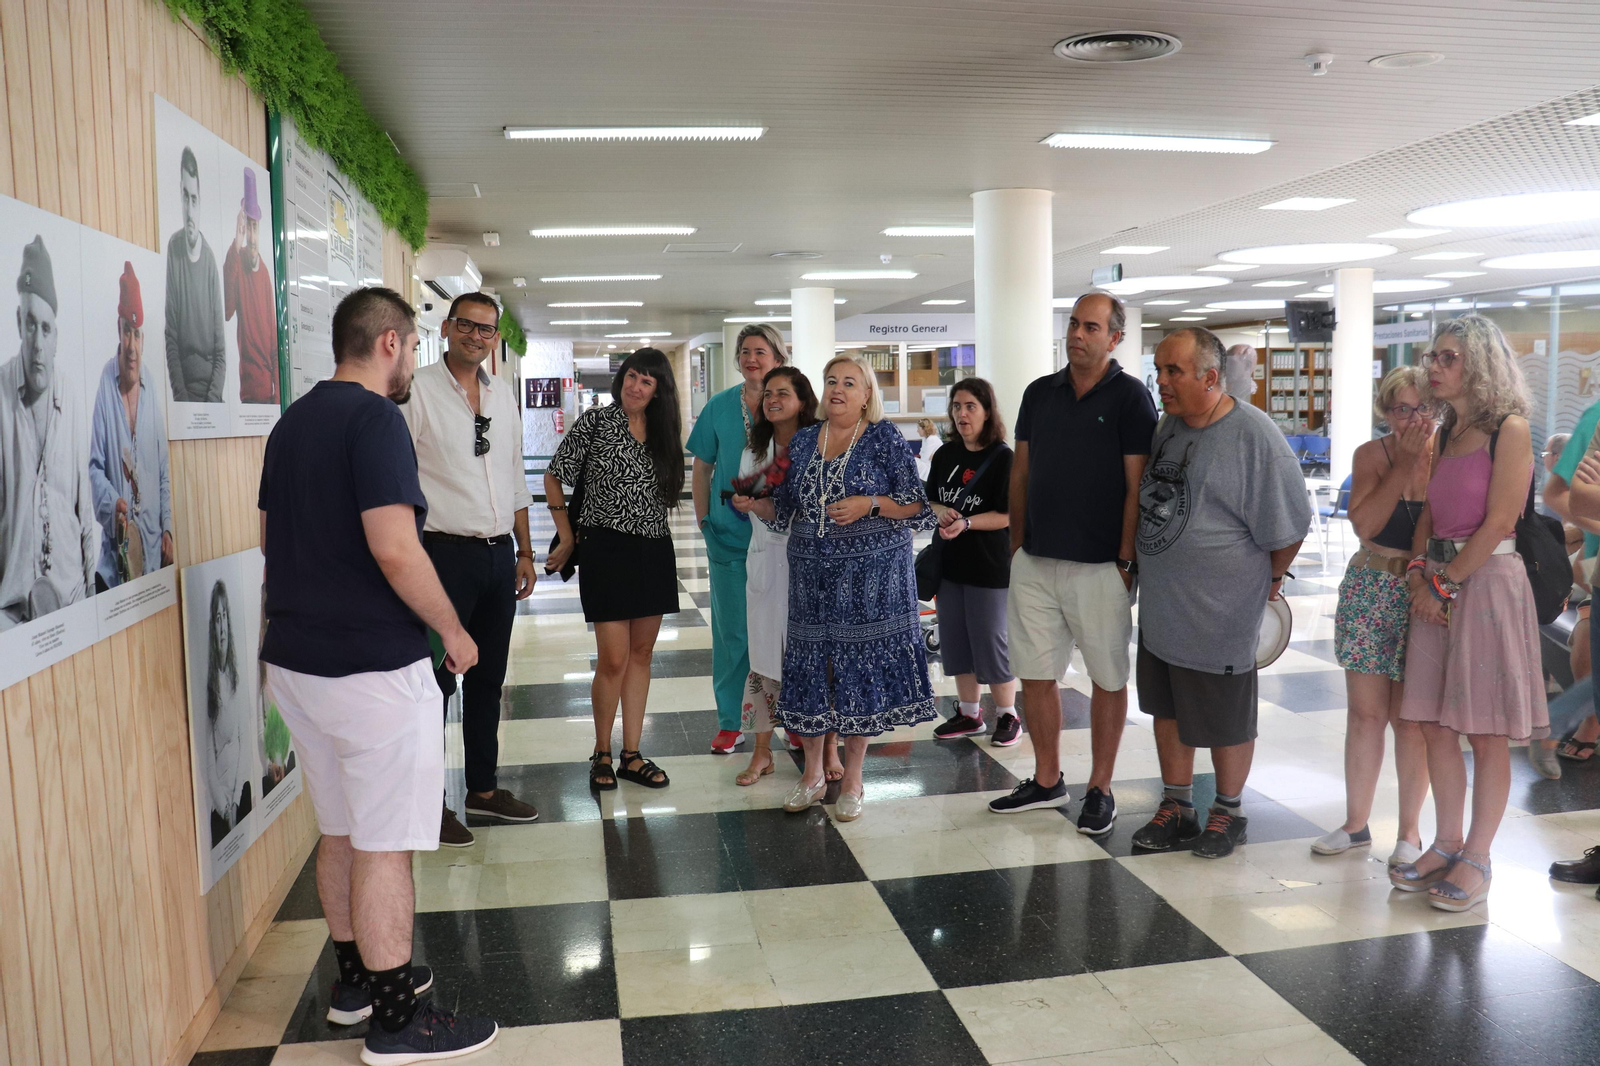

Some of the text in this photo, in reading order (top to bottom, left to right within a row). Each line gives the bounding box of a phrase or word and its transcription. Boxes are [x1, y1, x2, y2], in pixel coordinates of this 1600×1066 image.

[869, 325, 948, 335] Registro General
[1404, 328, 1428, 338] Sanitarias
